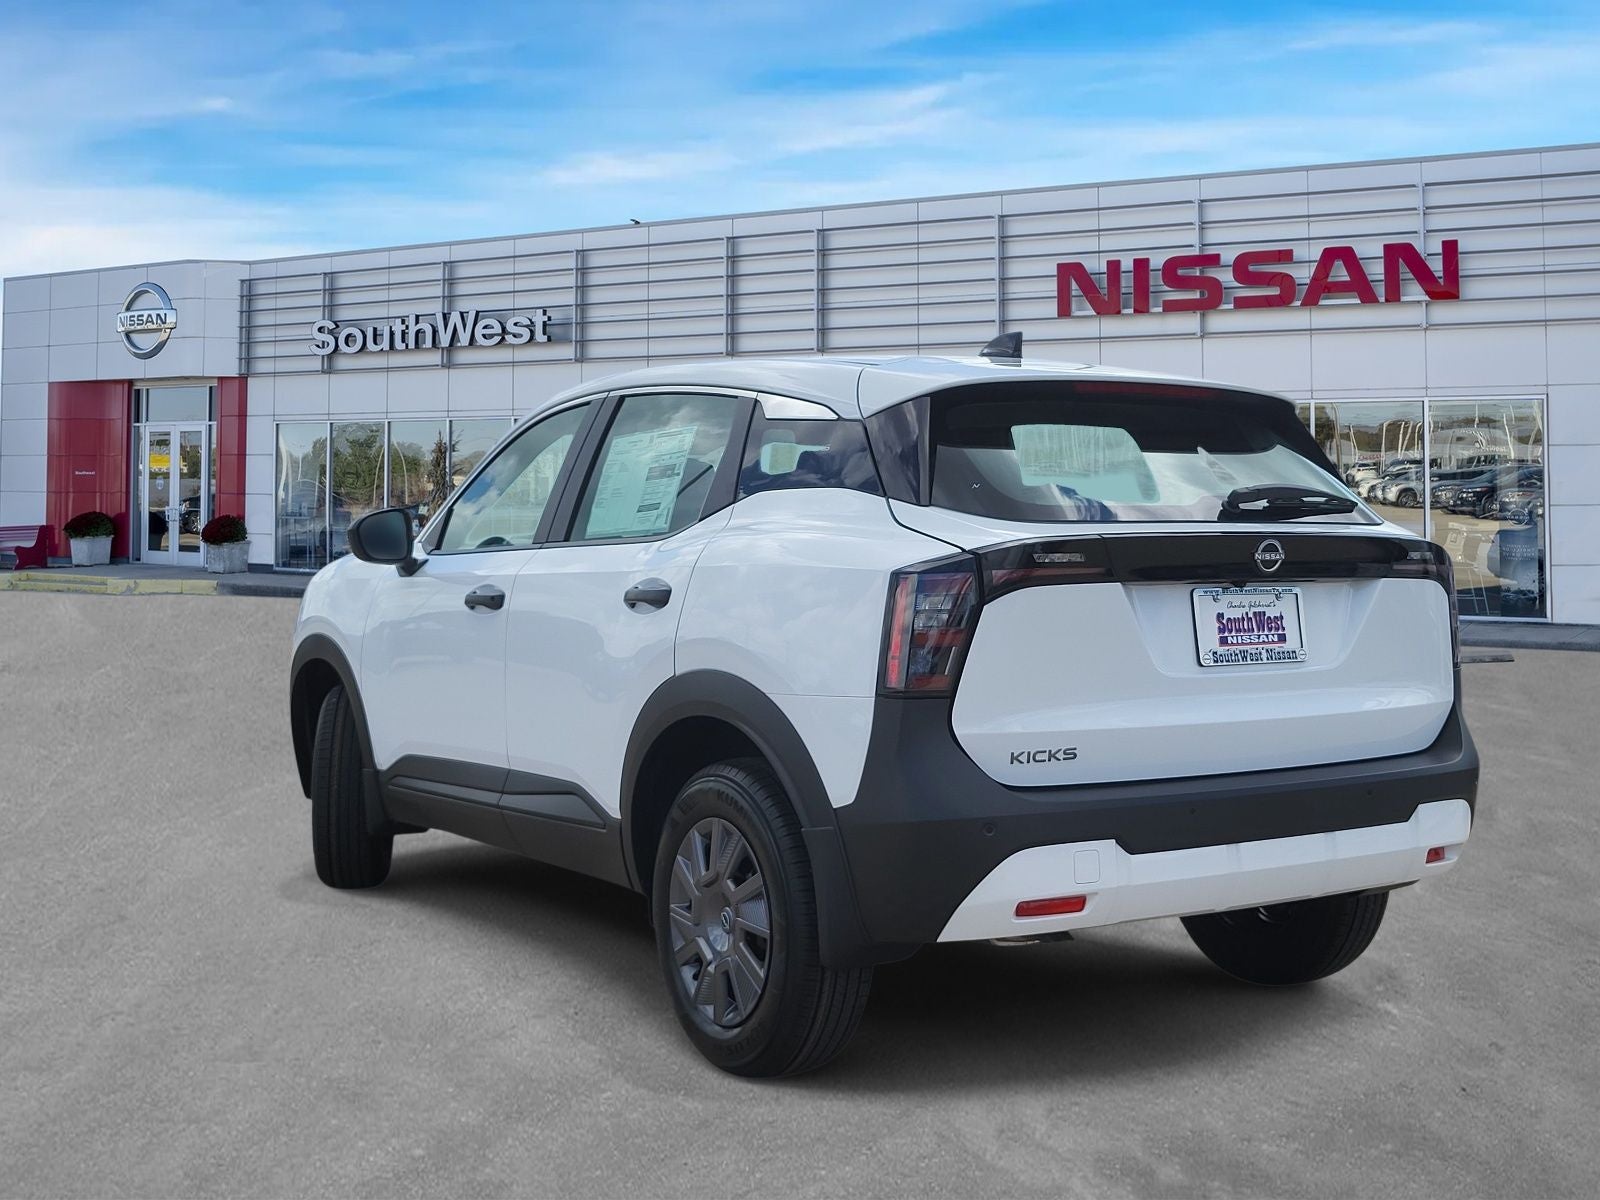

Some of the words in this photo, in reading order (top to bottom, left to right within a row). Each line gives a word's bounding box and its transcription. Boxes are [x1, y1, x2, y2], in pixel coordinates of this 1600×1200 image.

[1057, 239, 1460, 317] NISSAN
[119, 313, 167, 328] NISSAN
[309, 309, 551, 356] SouthWest
[1255, 552, 1285, 560] NISSAN
[1215, 610, 1286, 635] SouthWest
[1227, 634, 1278, 644] NISSAN
[1212, 649, 1263, 664] SouthWest
[1266, 648, 1298, 661] Nissan
[1010, 747, 1078, 765] KICKS
